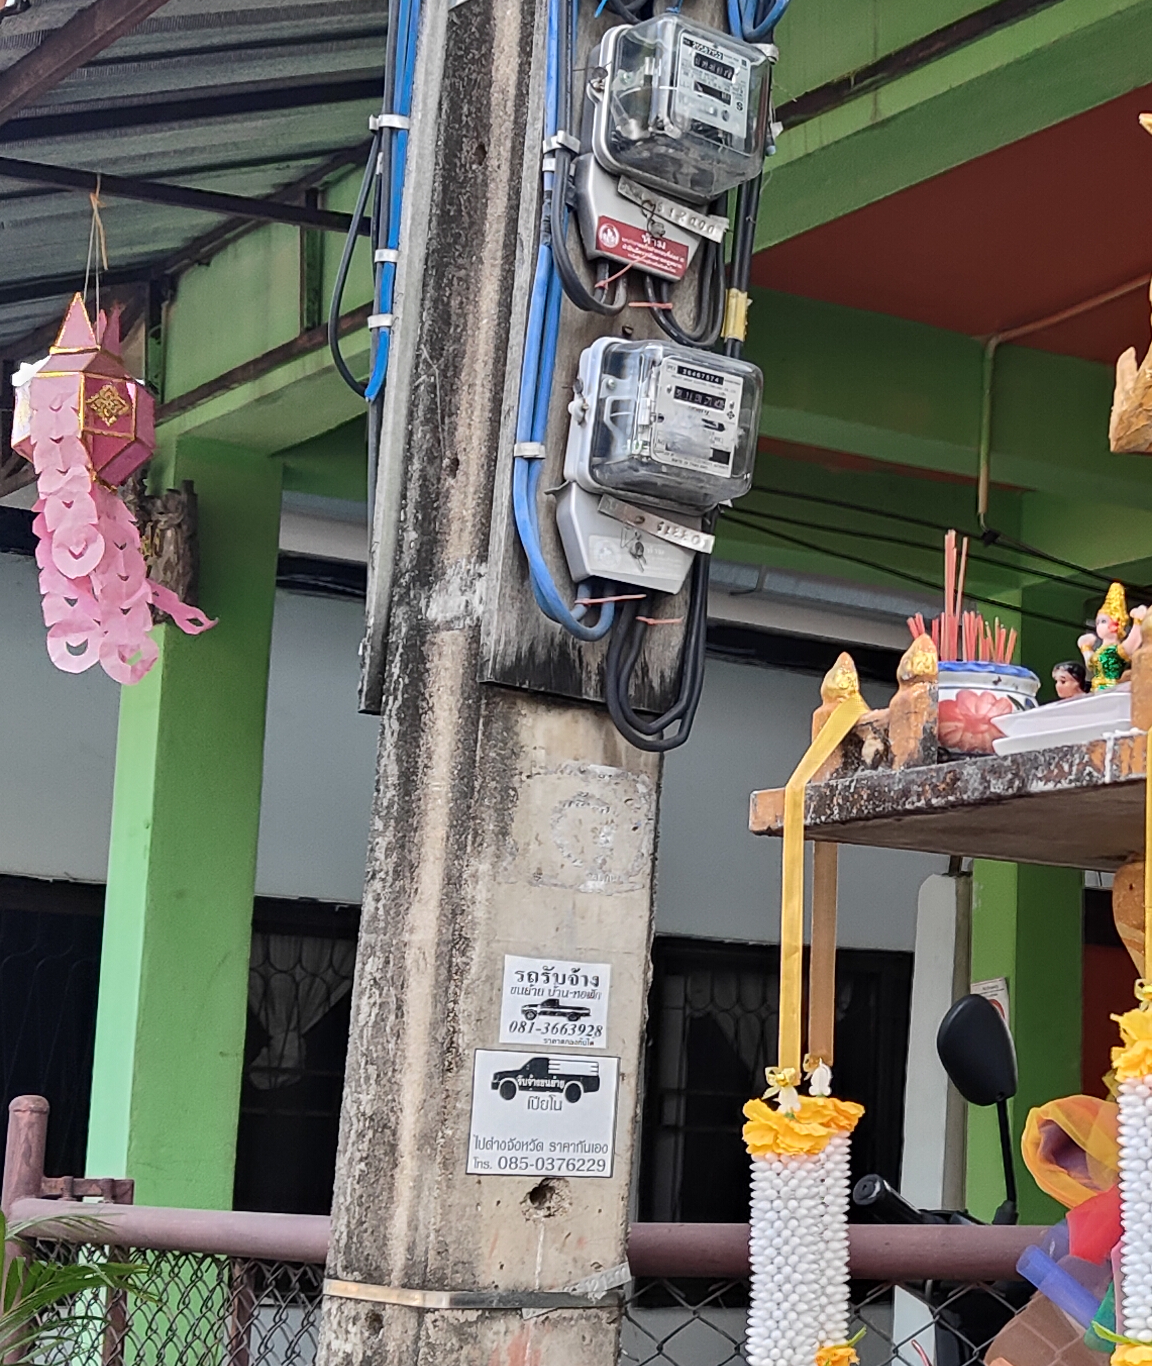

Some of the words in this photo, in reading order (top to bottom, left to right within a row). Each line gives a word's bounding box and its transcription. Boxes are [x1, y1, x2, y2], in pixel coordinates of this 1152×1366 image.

[514, 965, 600, 988] รถรับจ้าง
[510, 984, 545, 997] ขนย้าย
[509, 1020, 604, 1037] 081-3663928
[527, 1094, 563, 1111] เปียโน
[473, 1135, 544, 1153] ไปต่างจังหวัด
[549, 1139, 609, 1154] ราคากันเอง
[473, 1156, 492, 1170] โทร.
[497, 1155, 606, 1172] 085-0376229
